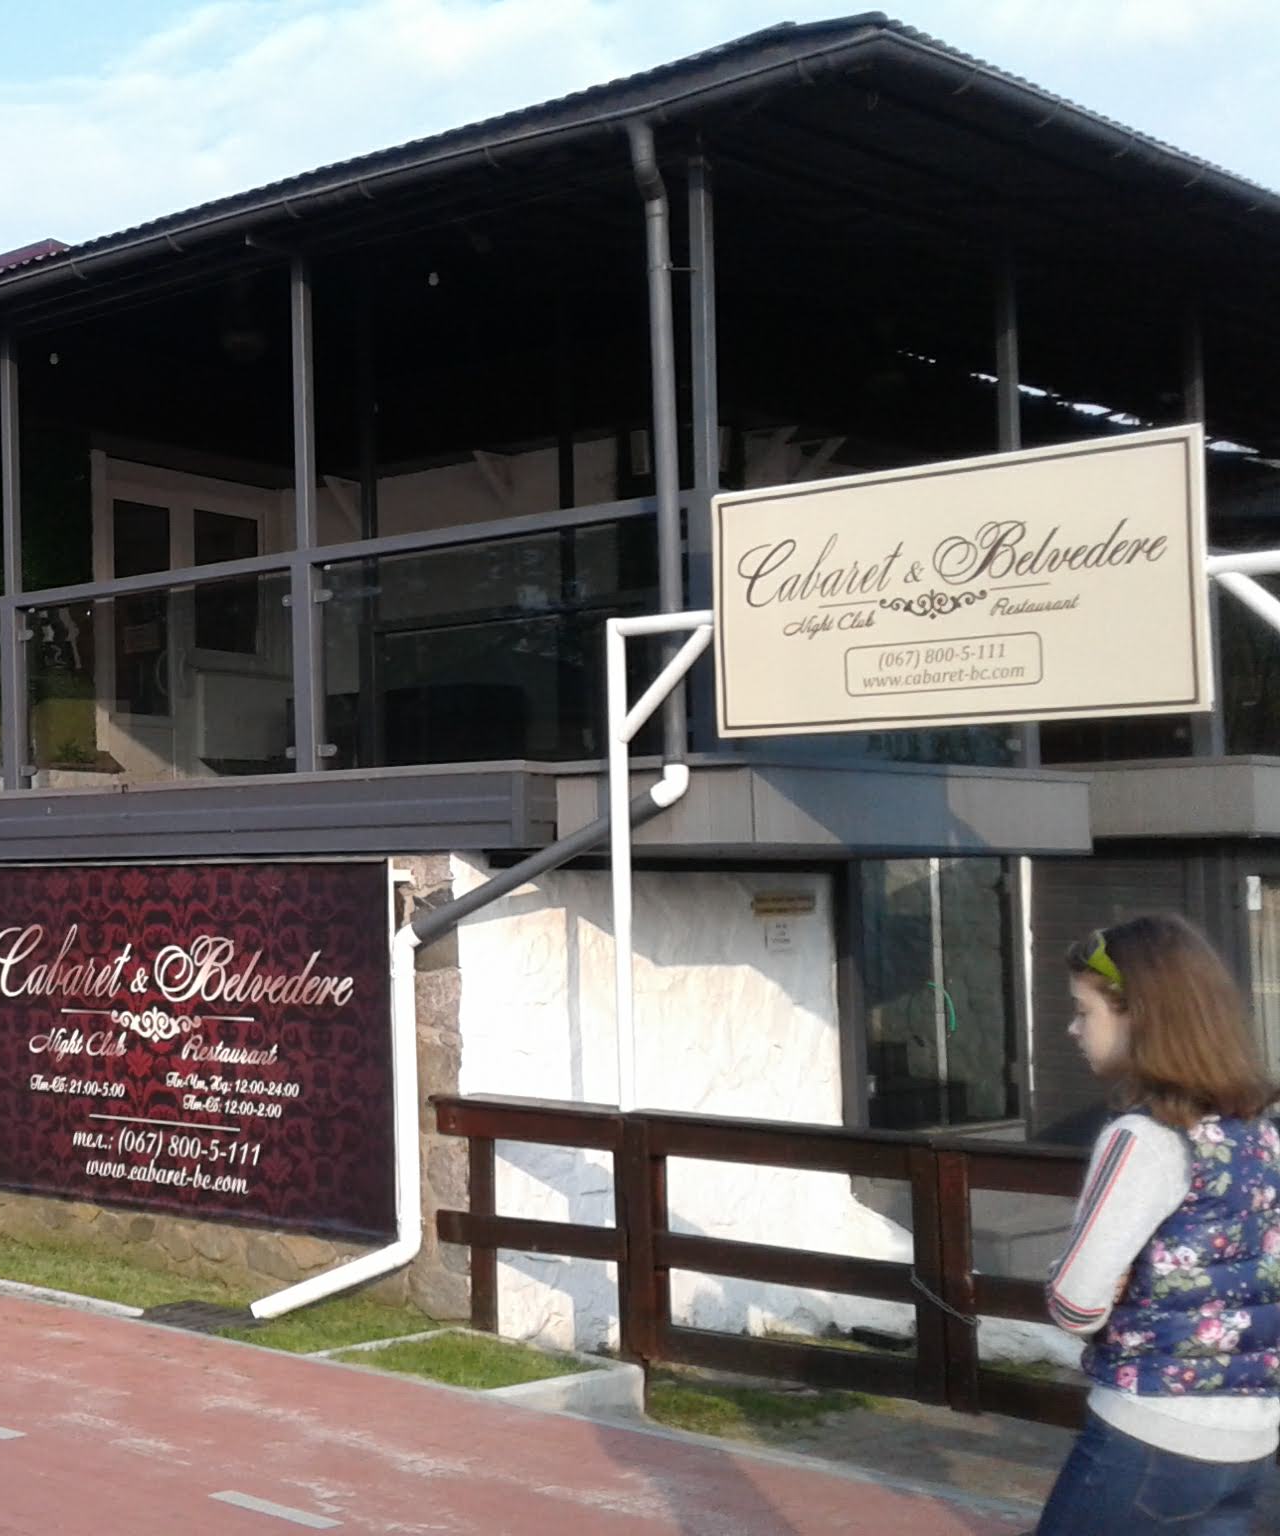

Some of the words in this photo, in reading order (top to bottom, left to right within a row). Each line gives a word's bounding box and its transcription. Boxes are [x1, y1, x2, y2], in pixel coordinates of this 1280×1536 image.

[737, 533, 903, 607] Cabaret
[903, 561, 925, 584] &
[932, 518, 1168, 585] Belvedere
[990, 595, 1080, 616] Restaurant
[783, 613, 833, 640] Night
[837, 610, 876, 631] Club
[878, 648, 920, 671] (067)
[925, 643, 1006, 665] 800-5-111
[863, 665, 1025, 689] www.cabaret-bc.com
[130, 967, 148, 994] &
[154, 935, 353, 1006] Belvedere
[29, 1028, 83, 1062] Night
[86, 1032, 127, 1057] Club
[181, 1034, 278, 1065] Restaurant
[118, 1126, 163, 1158] (067)
[168, 1134, 261, 1166] 800-5-111
[86, 1158, 249, 1194] www.cabaret-bc.com
